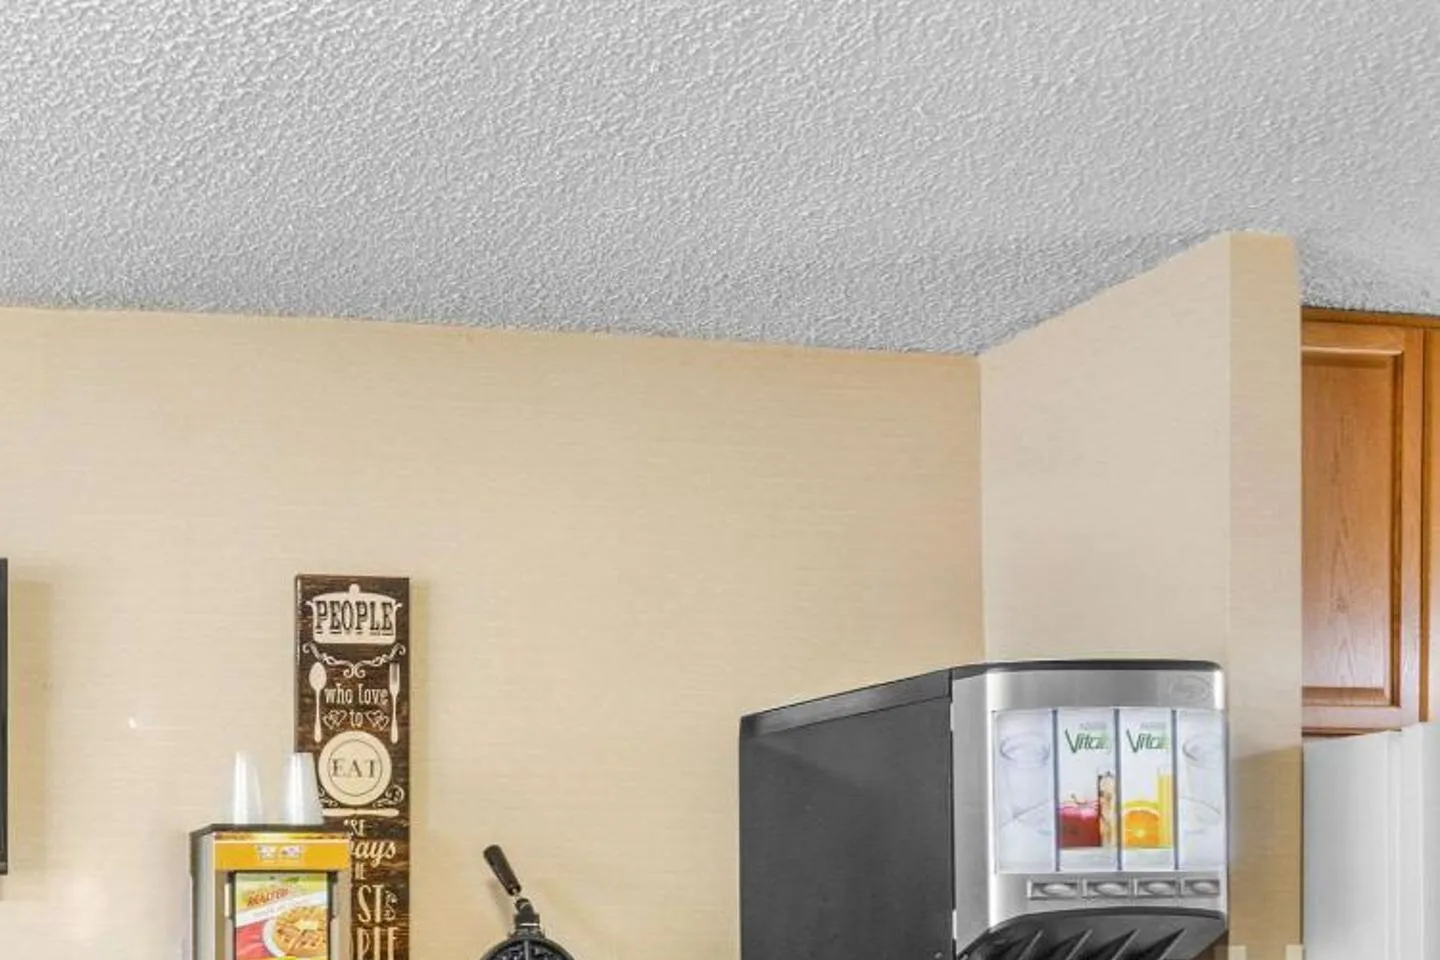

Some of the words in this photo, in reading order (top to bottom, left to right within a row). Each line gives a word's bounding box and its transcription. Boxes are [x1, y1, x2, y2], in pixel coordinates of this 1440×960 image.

[315, 600, 394, 632] PEOPLE
[324, 682, 353, 704] who
[358, 682, 389, 705] love
[350, 709, 363, 727] to
[331, 757, 379, 778] EAT
[357, 884, 385, 923] ST
